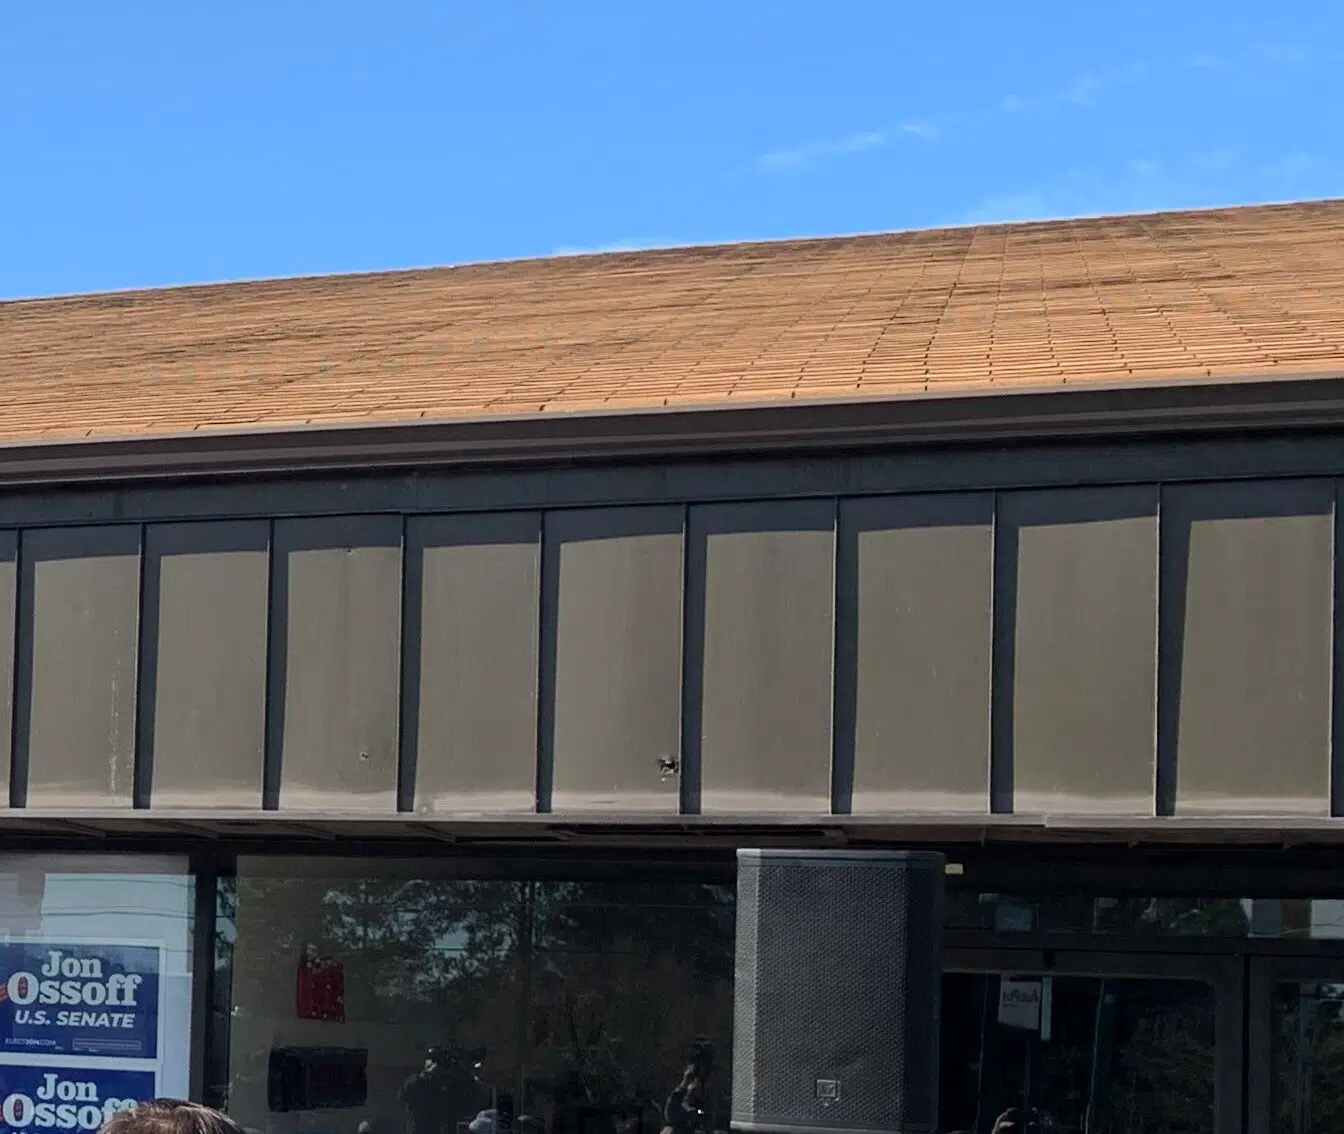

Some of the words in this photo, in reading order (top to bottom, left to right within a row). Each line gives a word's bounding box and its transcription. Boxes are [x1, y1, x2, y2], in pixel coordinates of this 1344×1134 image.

[41, 950, 103, 978] Jon
[7, 971, 143, 1006] Ossoff
[15, 1009, 51, 1025] U.S.
[55, 1010, 136, 1029] SENATE
[36, 1073, 99, 1102] Jon
